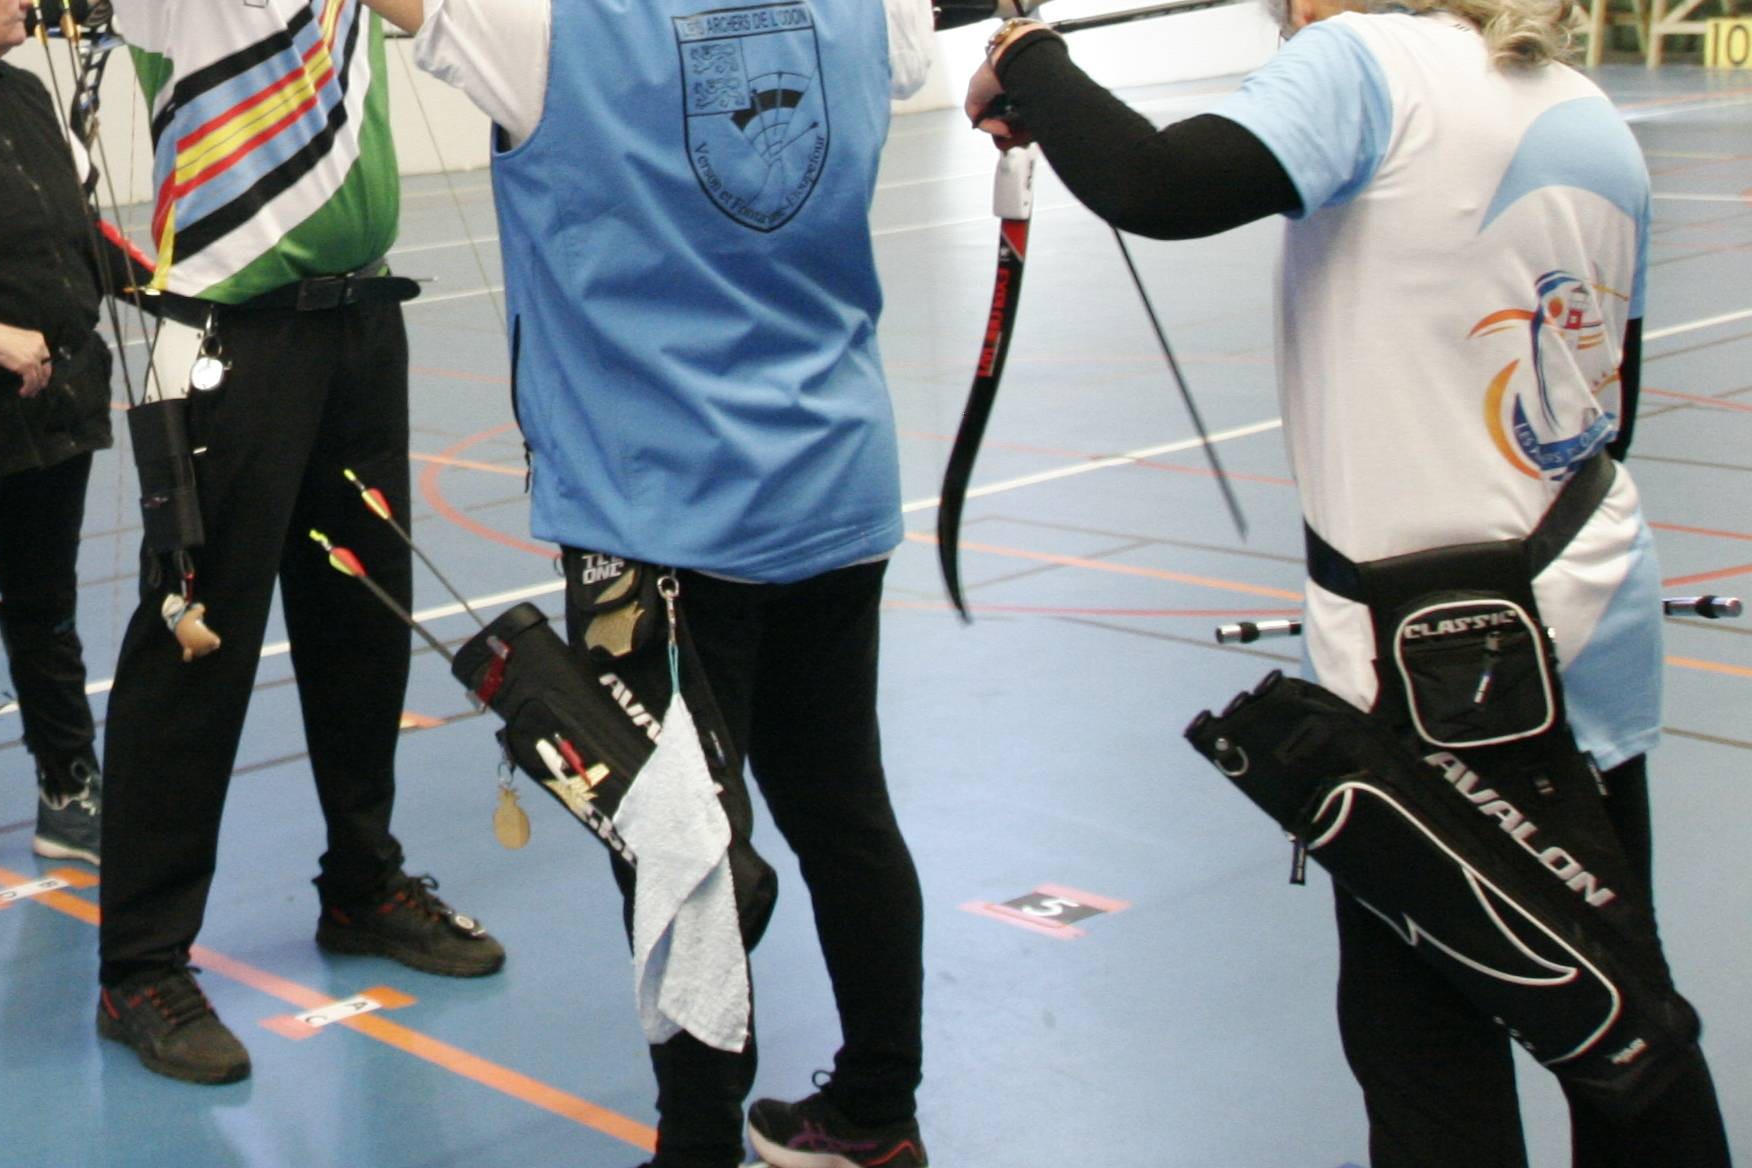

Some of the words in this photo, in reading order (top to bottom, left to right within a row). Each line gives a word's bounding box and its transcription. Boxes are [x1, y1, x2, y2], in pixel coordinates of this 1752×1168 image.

[1711, 22, 1751, 67] 10
[1403, 609, 1517, 639] CLASSIC
[1423, 750, 1617, 908] AVALON
[1021, 898, 1080, 917] 5
